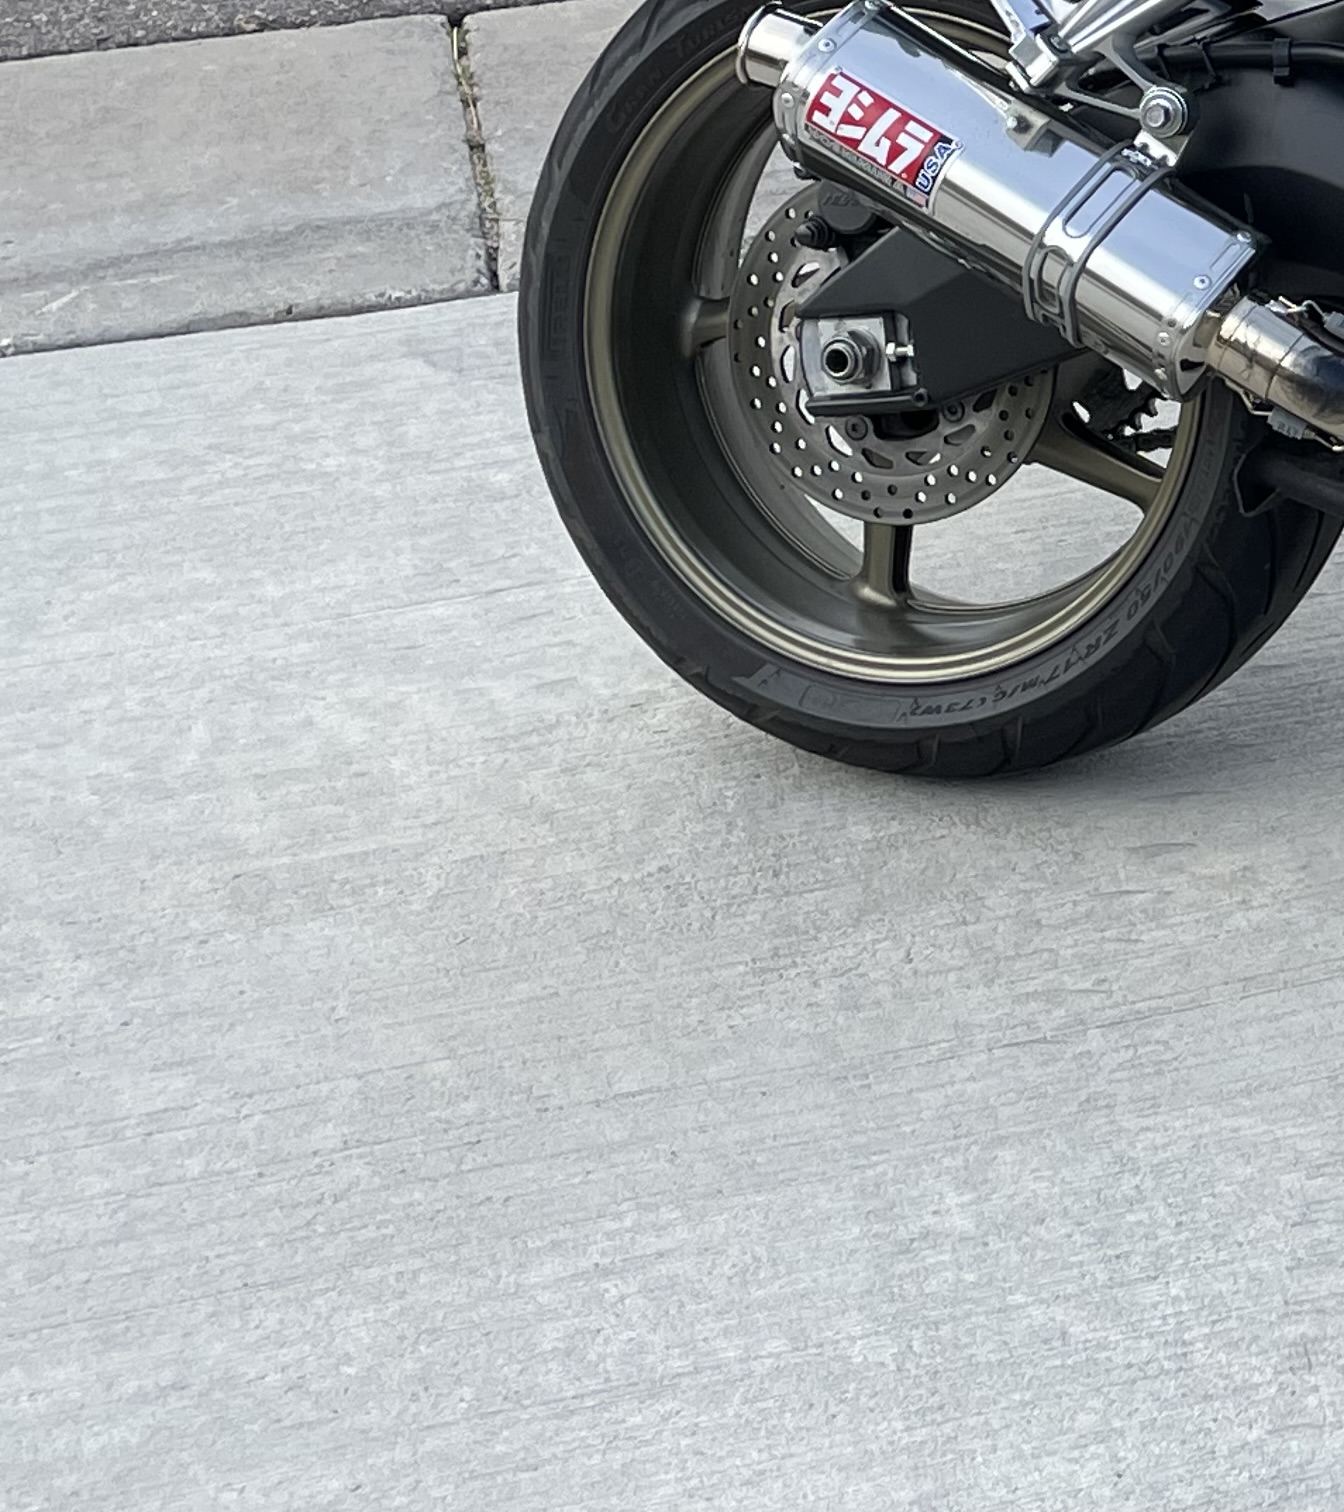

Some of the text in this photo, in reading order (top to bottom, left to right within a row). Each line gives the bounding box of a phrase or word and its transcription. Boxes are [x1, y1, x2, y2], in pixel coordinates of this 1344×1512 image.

[811, 74, 934, 175] ヨシムラ
[915, 140, 954, 192] USA
